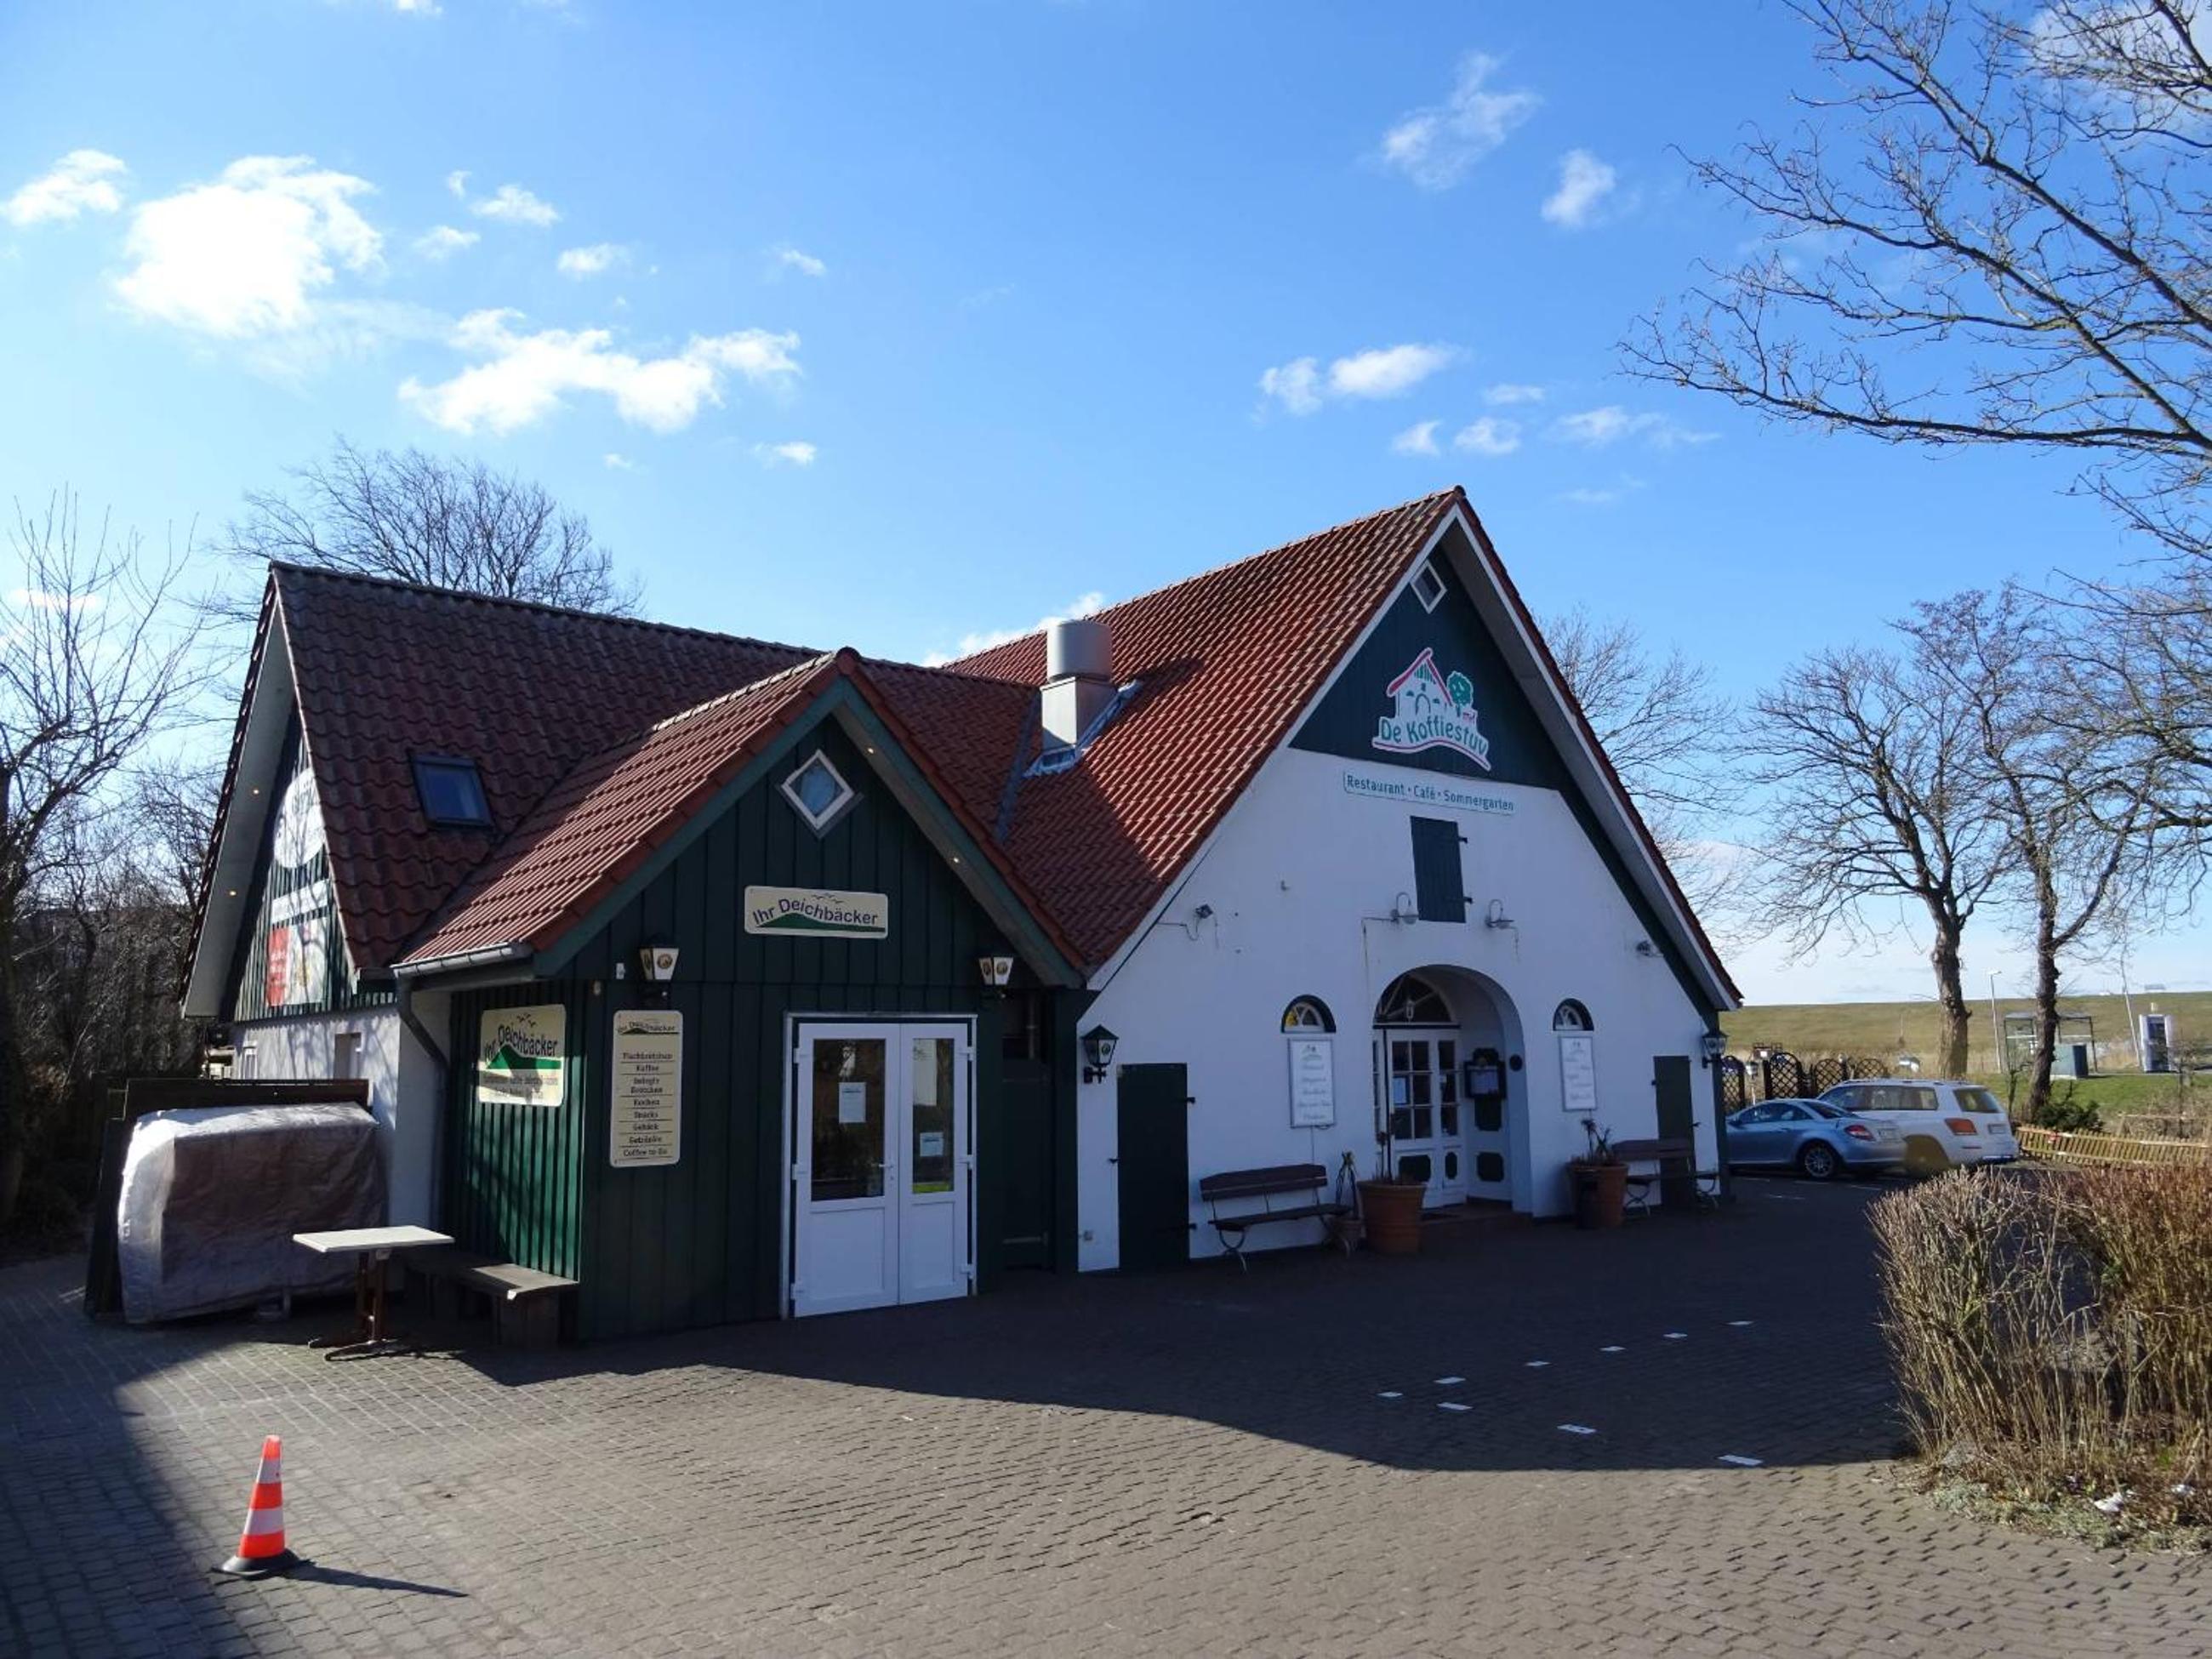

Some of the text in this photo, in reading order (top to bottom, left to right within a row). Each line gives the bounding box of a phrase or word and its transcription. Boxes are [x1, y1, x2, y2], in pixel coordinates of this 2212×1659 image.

[1381, 715, 1488, 755] De Koffiestuv
[1347, 775, 1514, 811] Restaurant Café Sommergarten
[753, 898, 879, 926] Ihr Deichbäcker
[498, 1023, 558, 1057] Deichbäcker
